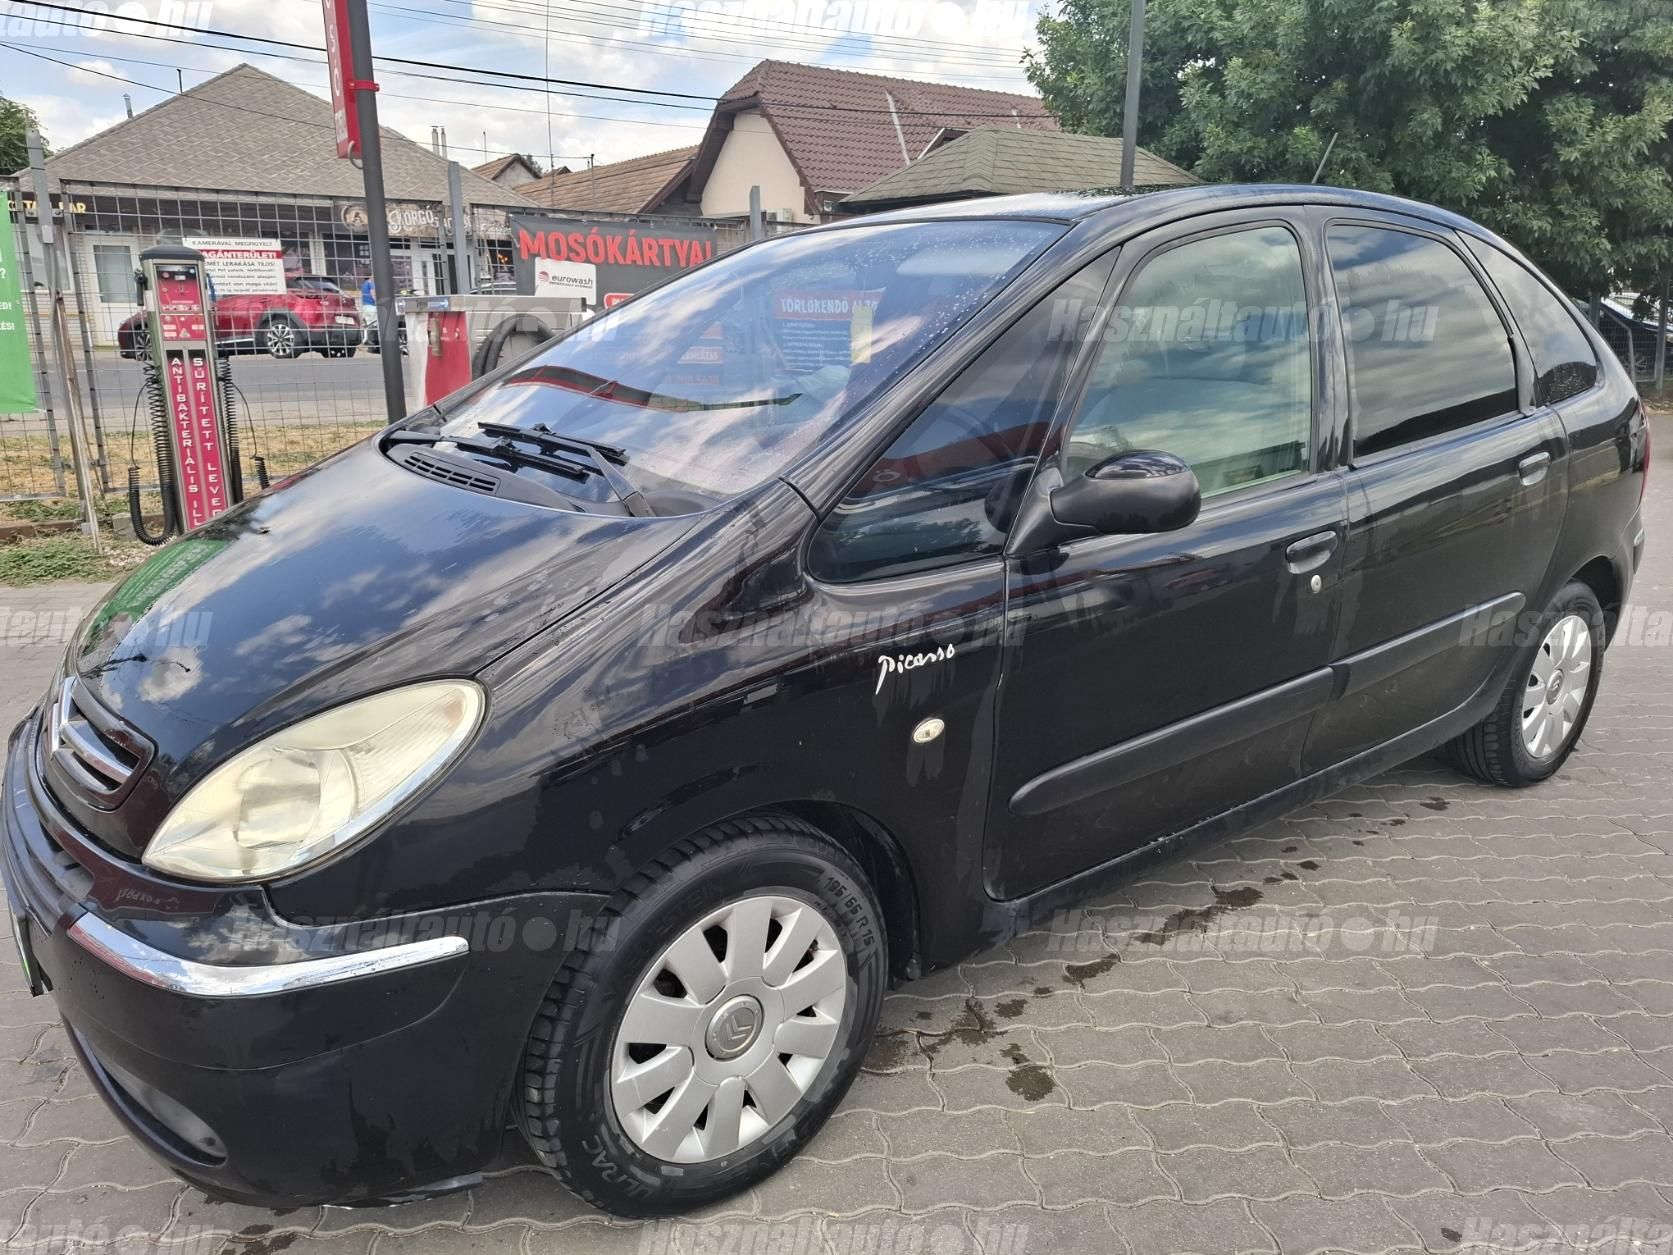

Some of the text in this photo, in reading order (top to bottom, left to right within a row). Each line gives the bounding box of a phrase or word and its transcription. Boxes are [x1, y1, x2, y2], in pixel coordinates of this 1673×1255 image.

[202, 250, 277, 259] AGÁNTERÜLET!
[552, 275, 593, 286] eurowash
[823, 876, 864, 916] 195/65
